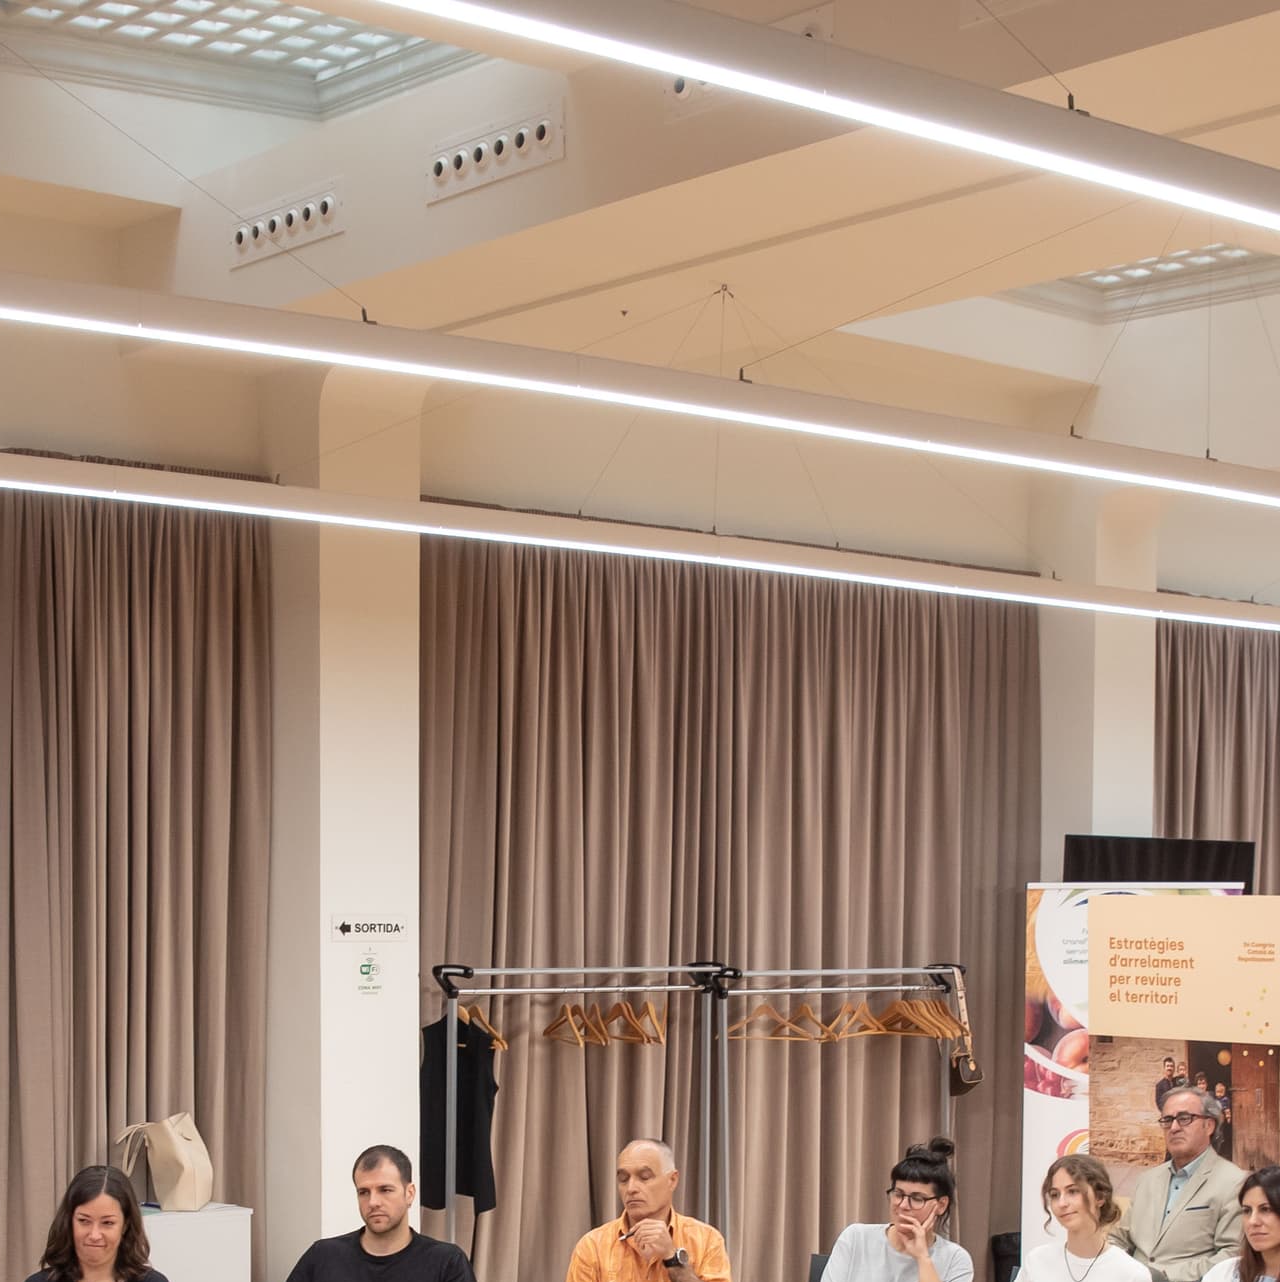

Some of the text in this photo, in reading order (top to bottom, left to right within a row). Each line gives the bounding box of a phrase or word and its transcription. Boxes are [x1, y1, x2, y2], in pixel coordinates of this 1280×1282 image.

[354, 923, 401, 933] SORTIDA
[1109, 936, 1185, 955] Estratègies
[1109, 954, 1195, 969] d'arrelament
[1109, 973, 1181, 988] per reviure
[1109, 989, 1178, 1005] el territori
